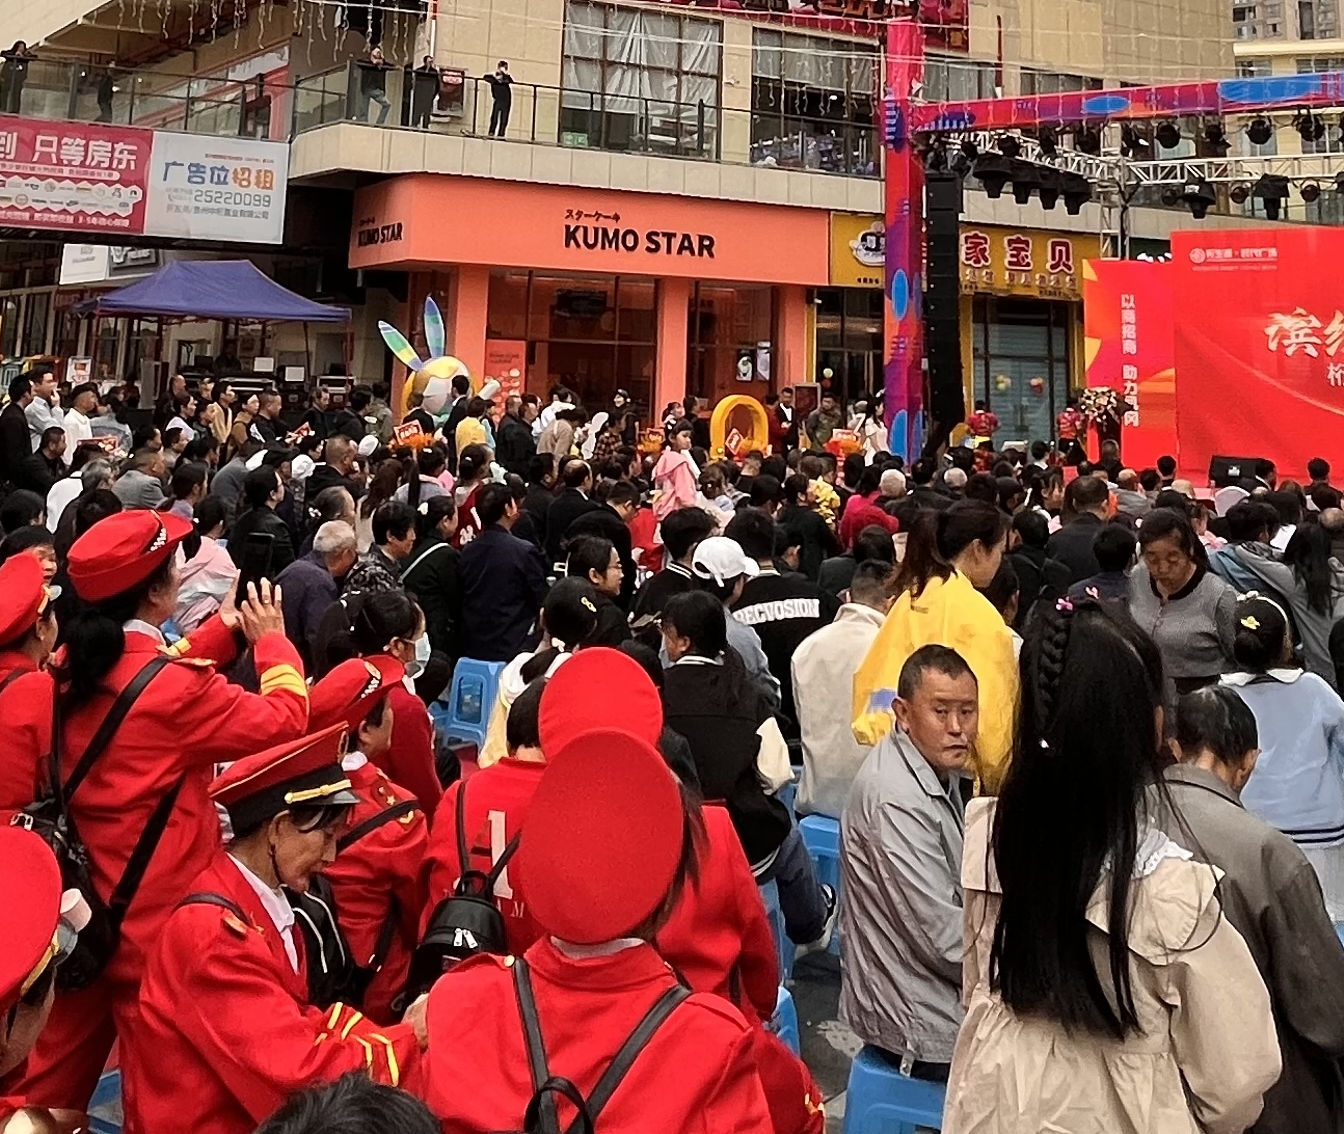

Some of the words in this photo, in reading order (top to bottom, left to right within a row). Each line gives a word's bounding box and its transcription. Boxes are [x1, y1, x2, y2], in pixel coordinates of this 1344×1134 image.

[32, 134, 137, 170] 只等房东
[162, 161, 274, 190] 广告位招租
[194, 189, 271, 207] 25220099
[358, 226, 379, 248] KUMO
[380, 222, 403, 242] STAR
[564, 224, 640, 252] KUMO
[645, 230, 716, 259] STAR
[962, 231, 1075, 273] 家宝贝
